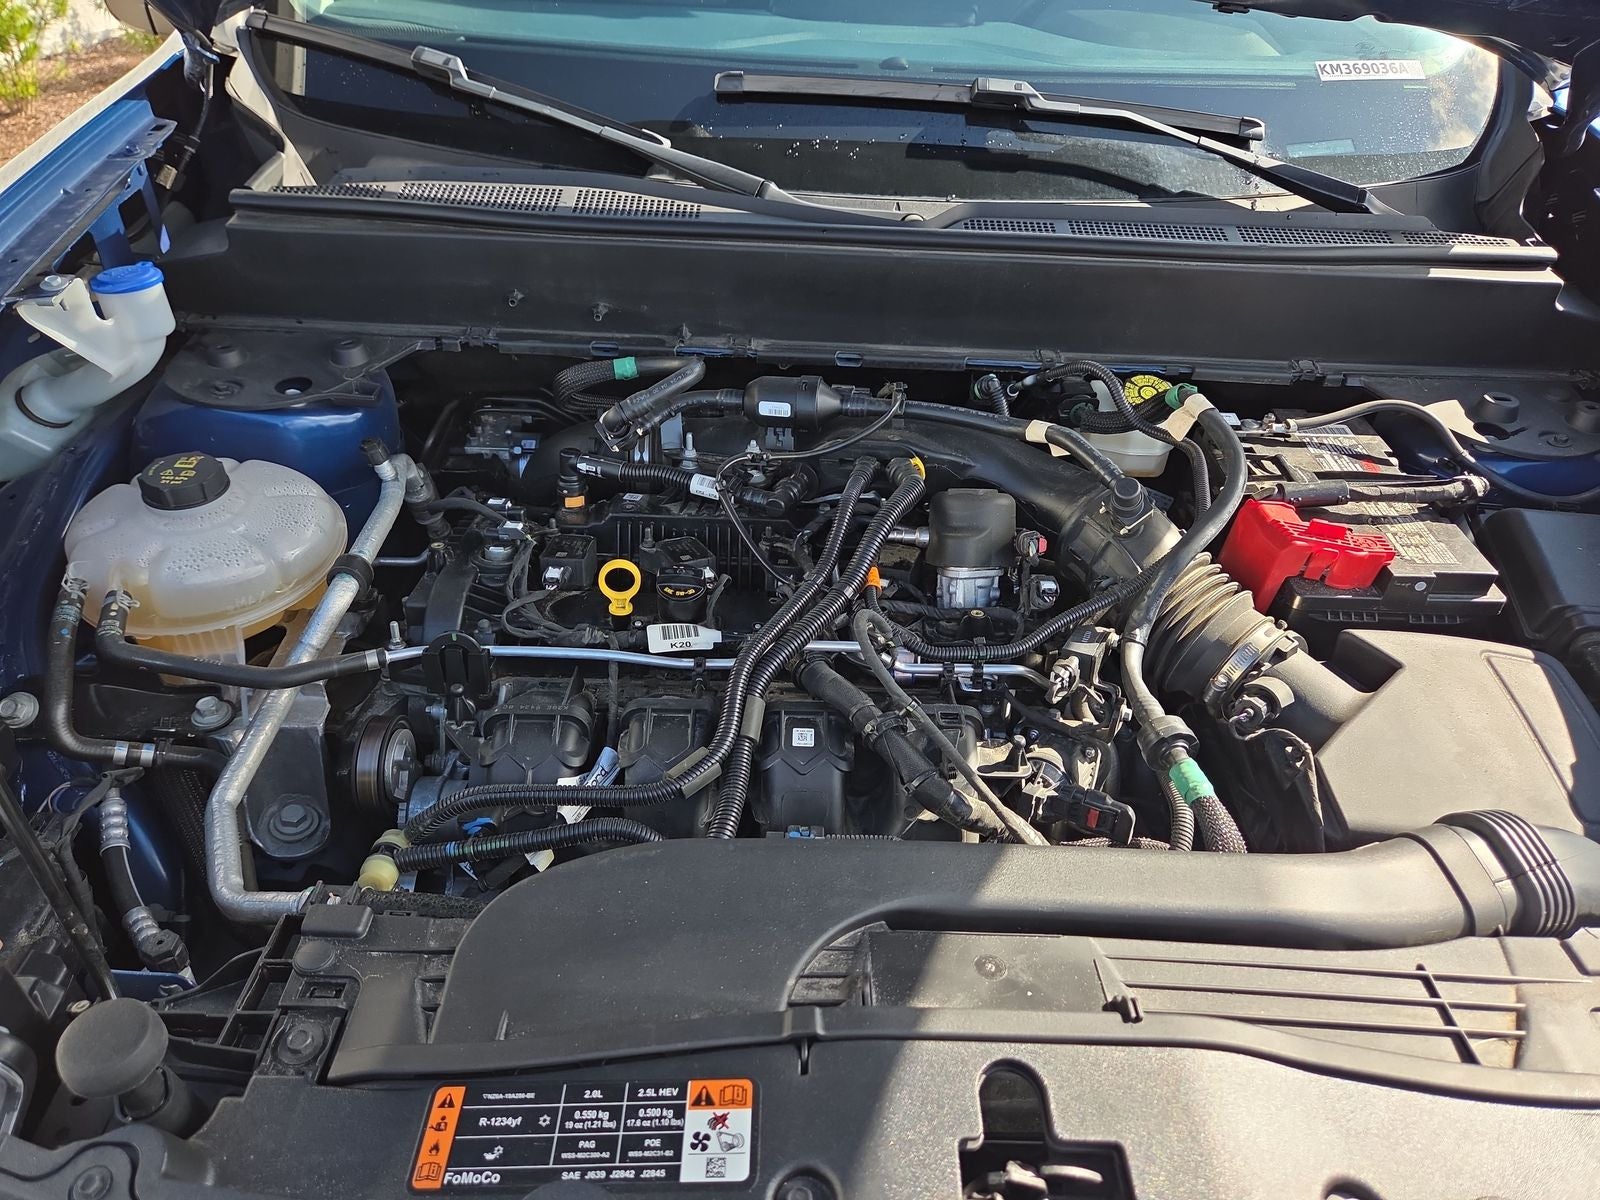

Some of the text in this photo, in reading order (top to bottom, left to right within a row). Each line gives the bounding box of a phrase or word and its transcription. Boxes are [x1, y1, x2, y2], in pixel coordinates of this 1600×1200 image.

[670, 641, 692, 649] K20
[638, 1087, 679, 1097] 2.5L HEV
[598, 1110, 610, 1120] kg
[638, 1107, 674, 1118] 0.500 kg
[478, 1116, 522, 1128] R-1234yf
[565, 1121, 574, 1129] 19
[578, 1140, 596, 1148] PAG
[443, 1172, 501, 1184] FoMoCo
[561, 1171, 581, 1180] SAE
[584, 1170, 606, 1180] J639
